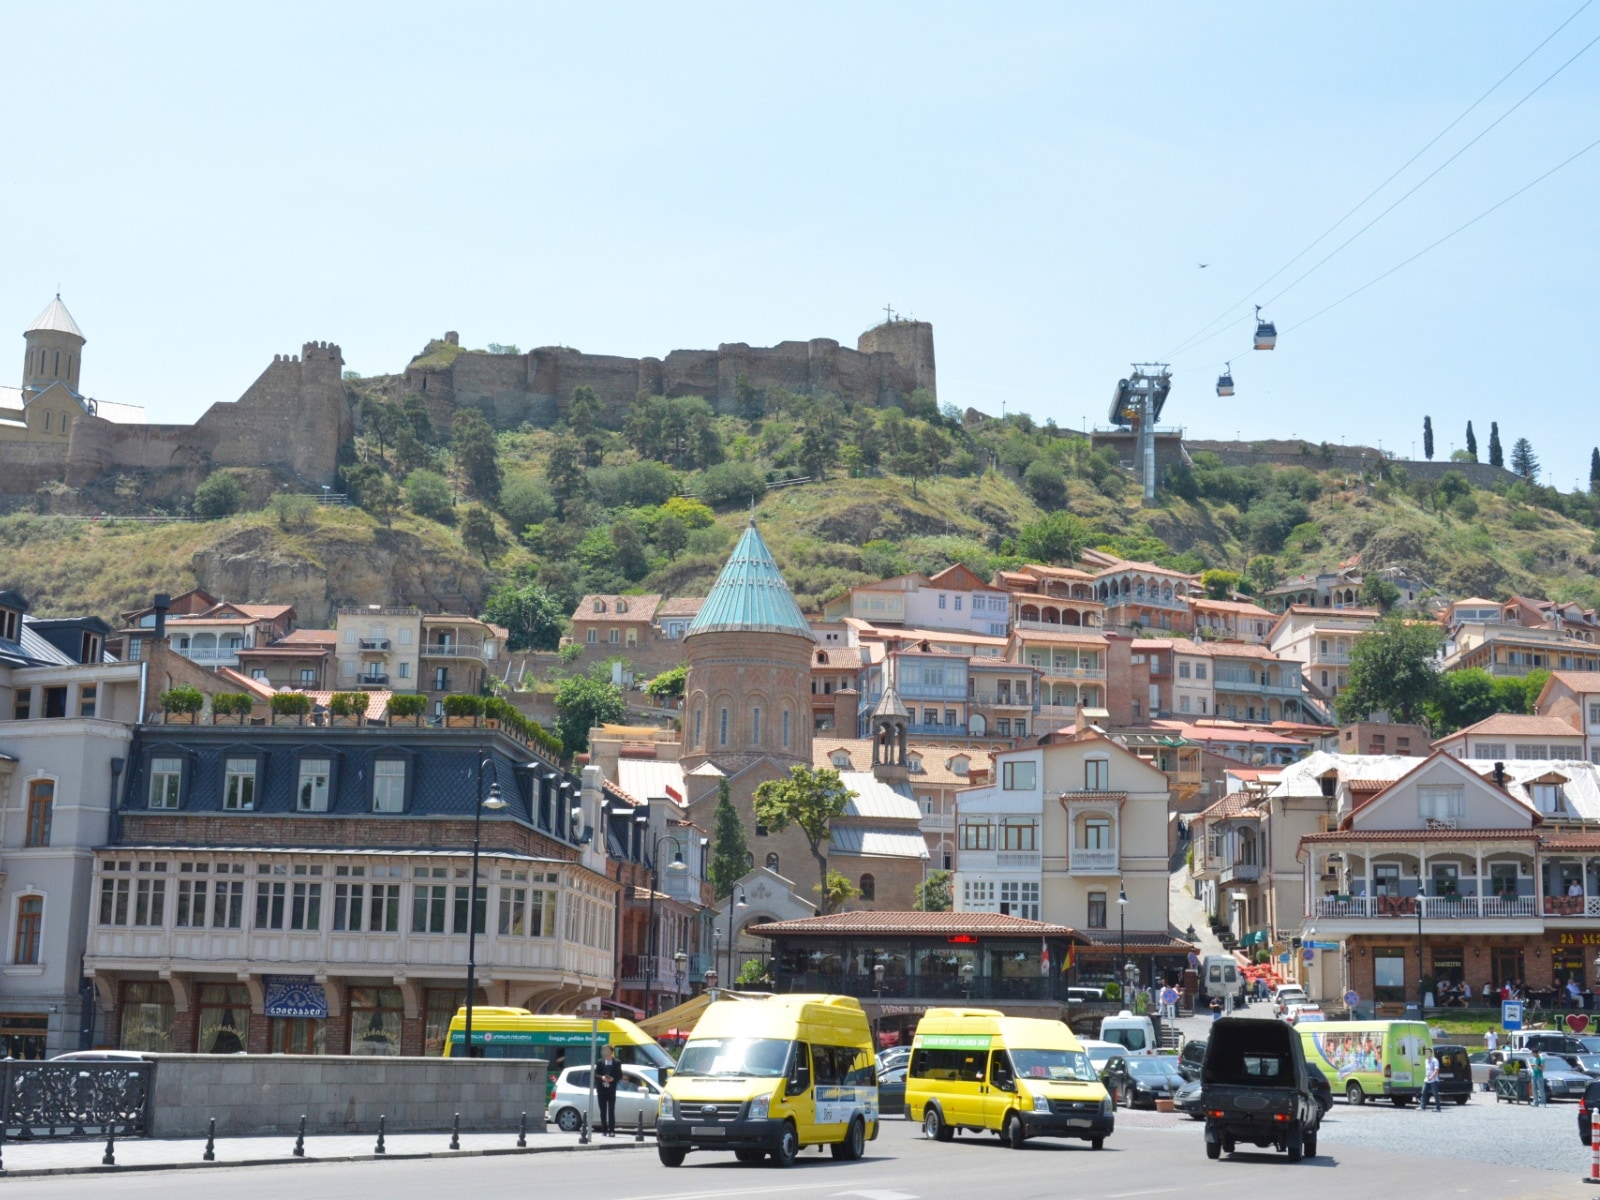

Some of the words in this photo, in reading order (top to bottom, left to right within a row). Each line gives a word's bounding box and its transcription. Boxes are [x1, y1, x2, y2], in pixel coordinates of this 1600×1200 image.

[880, 1005, 909, 1013] WINE
[1554, 1014, 1564, 1032] I
[1030, 1065, 1047, 1076] 131
